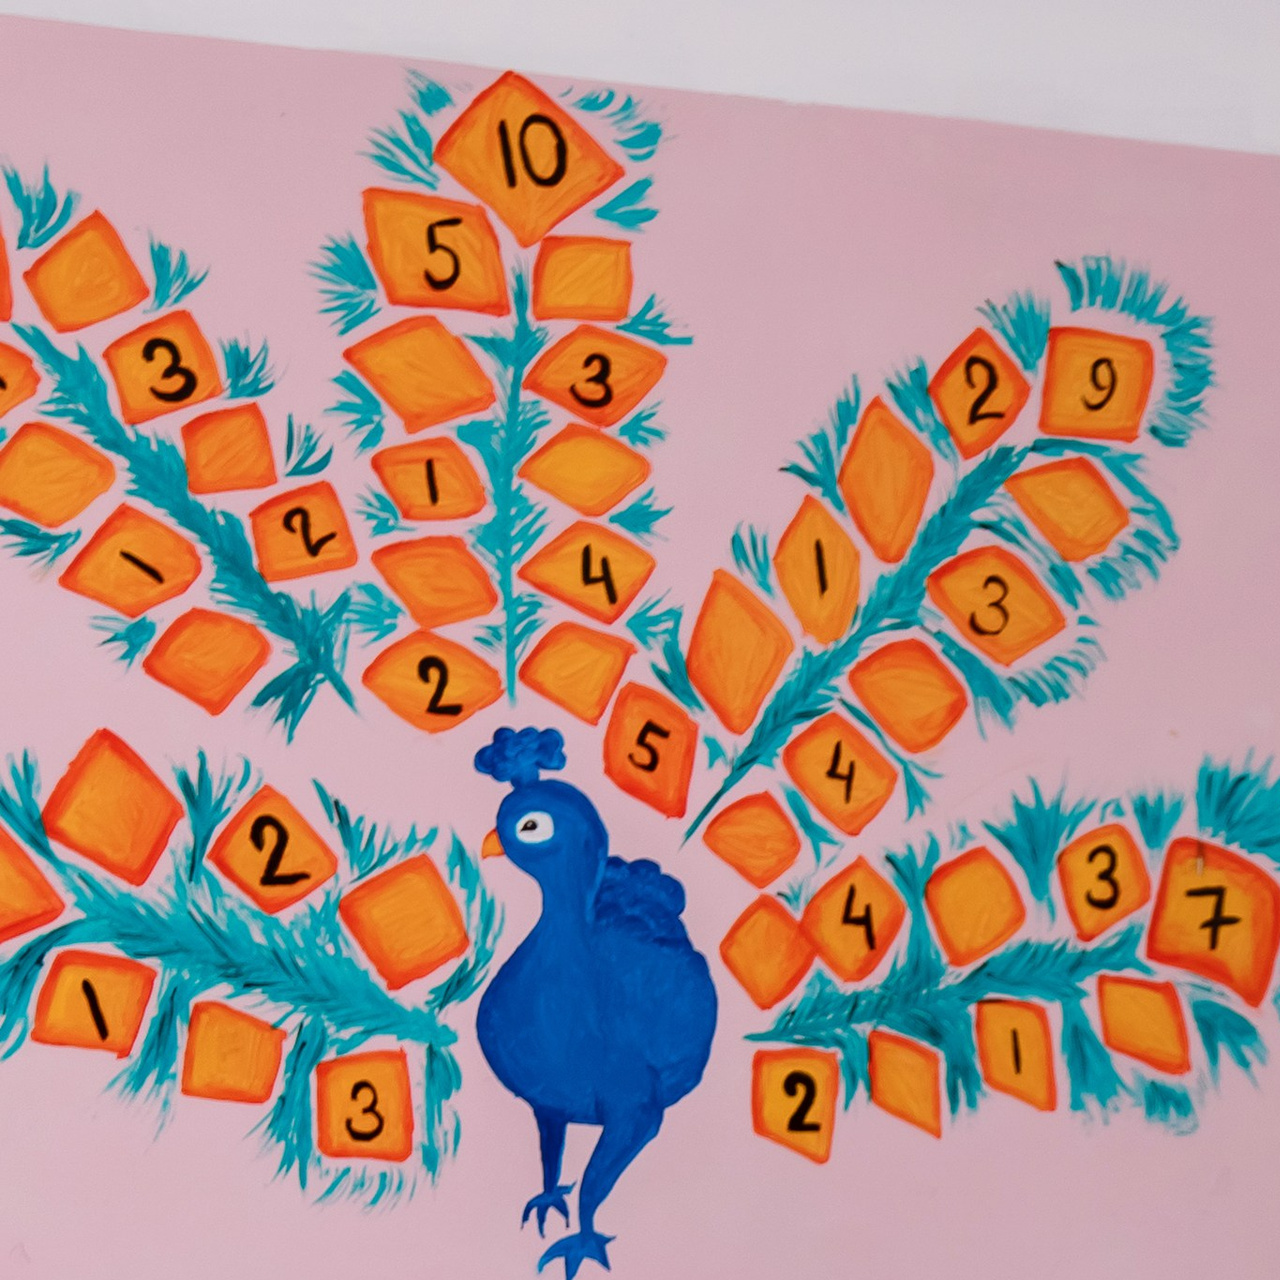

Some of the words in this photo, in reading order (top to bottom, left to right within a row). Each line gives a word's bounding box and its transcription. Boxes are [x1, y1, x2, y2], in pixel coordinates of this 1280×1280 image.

[498, 114, 568, 188] 10
[424, 217, 463, 291] 5
[142, 337, 197, 403] 3
[569, 352, 614, 408] 3
[964, 356, 1005, 425] 2
[1083, 357, 1118, 411] 9
[425, 458, 439, 505] 1
[282, 506, 337, 557] 2
[119, 550, 164, 584] 1
[581, 544, 618, 604] 4
[814, 539, 828, 595] 1
[969, 574, 1009, 636] 3
[417, 655, 463, 716] 2
[627, 721, 671, 773] 5
[825, 740, 856, 803] 4
[249, 814, 311, 886] 2
[1086, 844, 1120, 911] 3
[841, 884, 876, 951] 4
[1185, 885, 1241, 951] 7
[81, 978, 109, 1041] 1
[1011, 1029, 1022, 1074] 1
[344, 1080, 385, 1142] 3
[782, 1070, 822, 1133] 2
